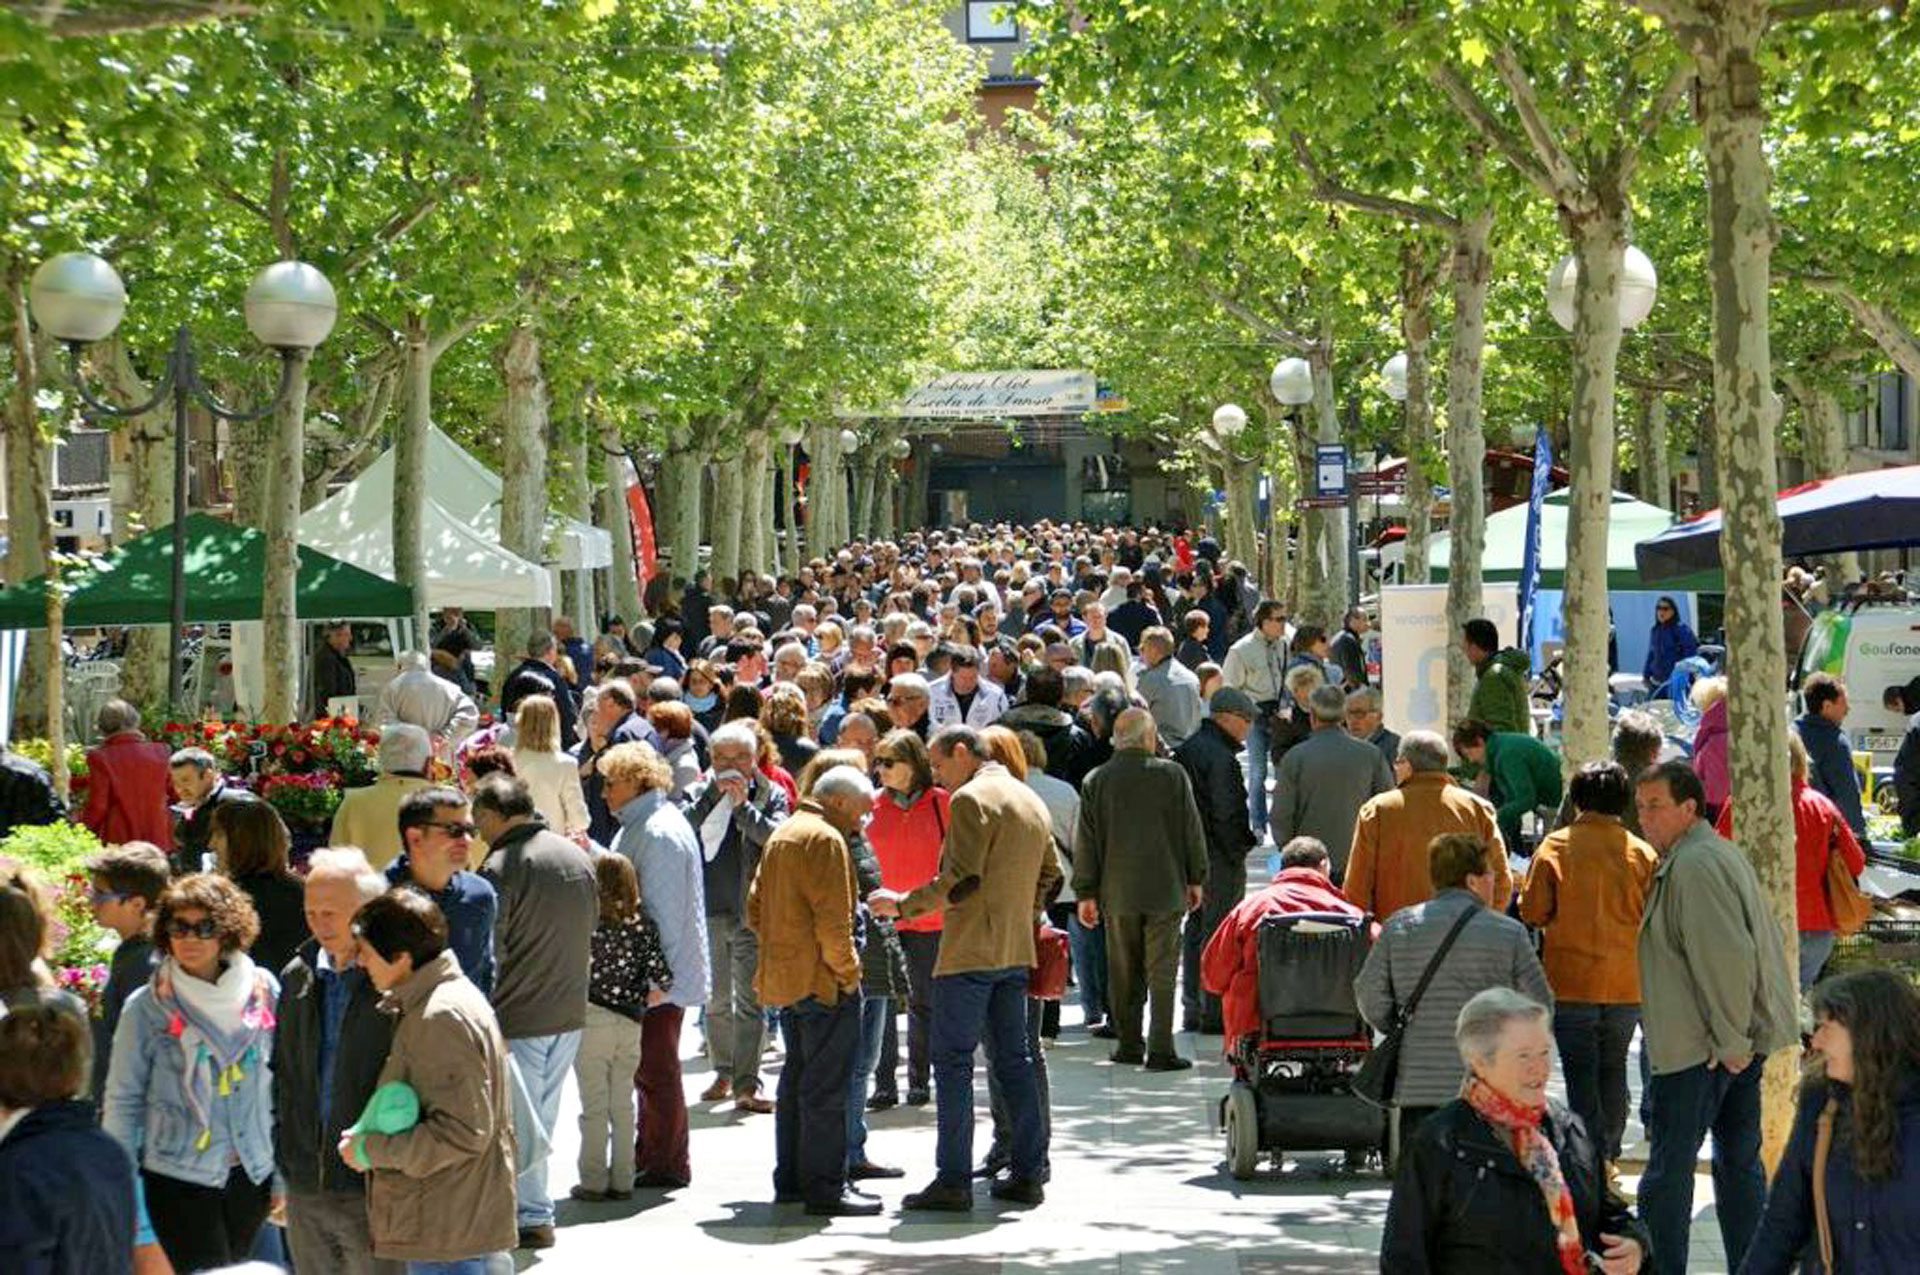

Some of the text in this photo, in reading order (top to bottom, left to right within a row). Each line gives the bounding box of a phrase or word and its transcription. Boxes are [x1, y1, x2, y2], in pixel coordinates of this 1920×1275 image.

[905, 391, 962, 407] Escola
[967, 393, 984, 406] de
[996, 391, 1053, 406] Dansa
